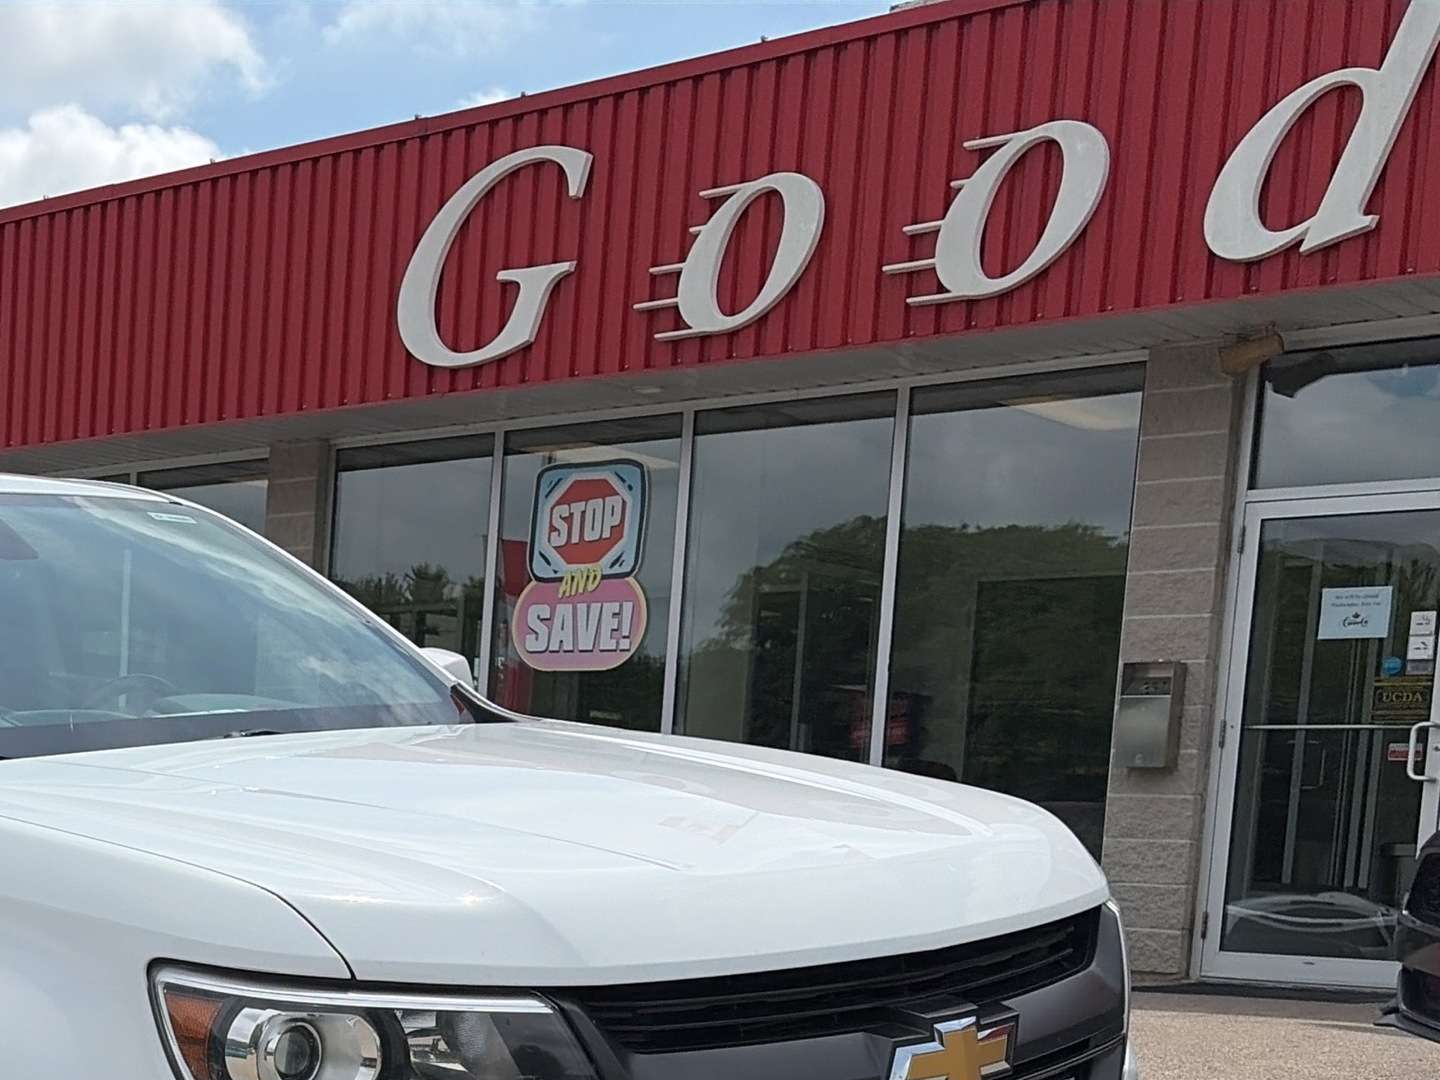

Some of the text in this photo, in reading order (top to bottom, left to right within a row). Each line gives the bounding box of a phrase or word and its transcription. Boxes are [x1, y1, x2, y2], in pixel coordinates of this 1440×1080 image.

[397, 0, 1440, 368] Good
[550, 496, 624, 548] STOP
[559, 566, 602, 598] AND
[525, 602, 634, 653] SAVE!
[1382, 690, 1423, 703] UCDA
